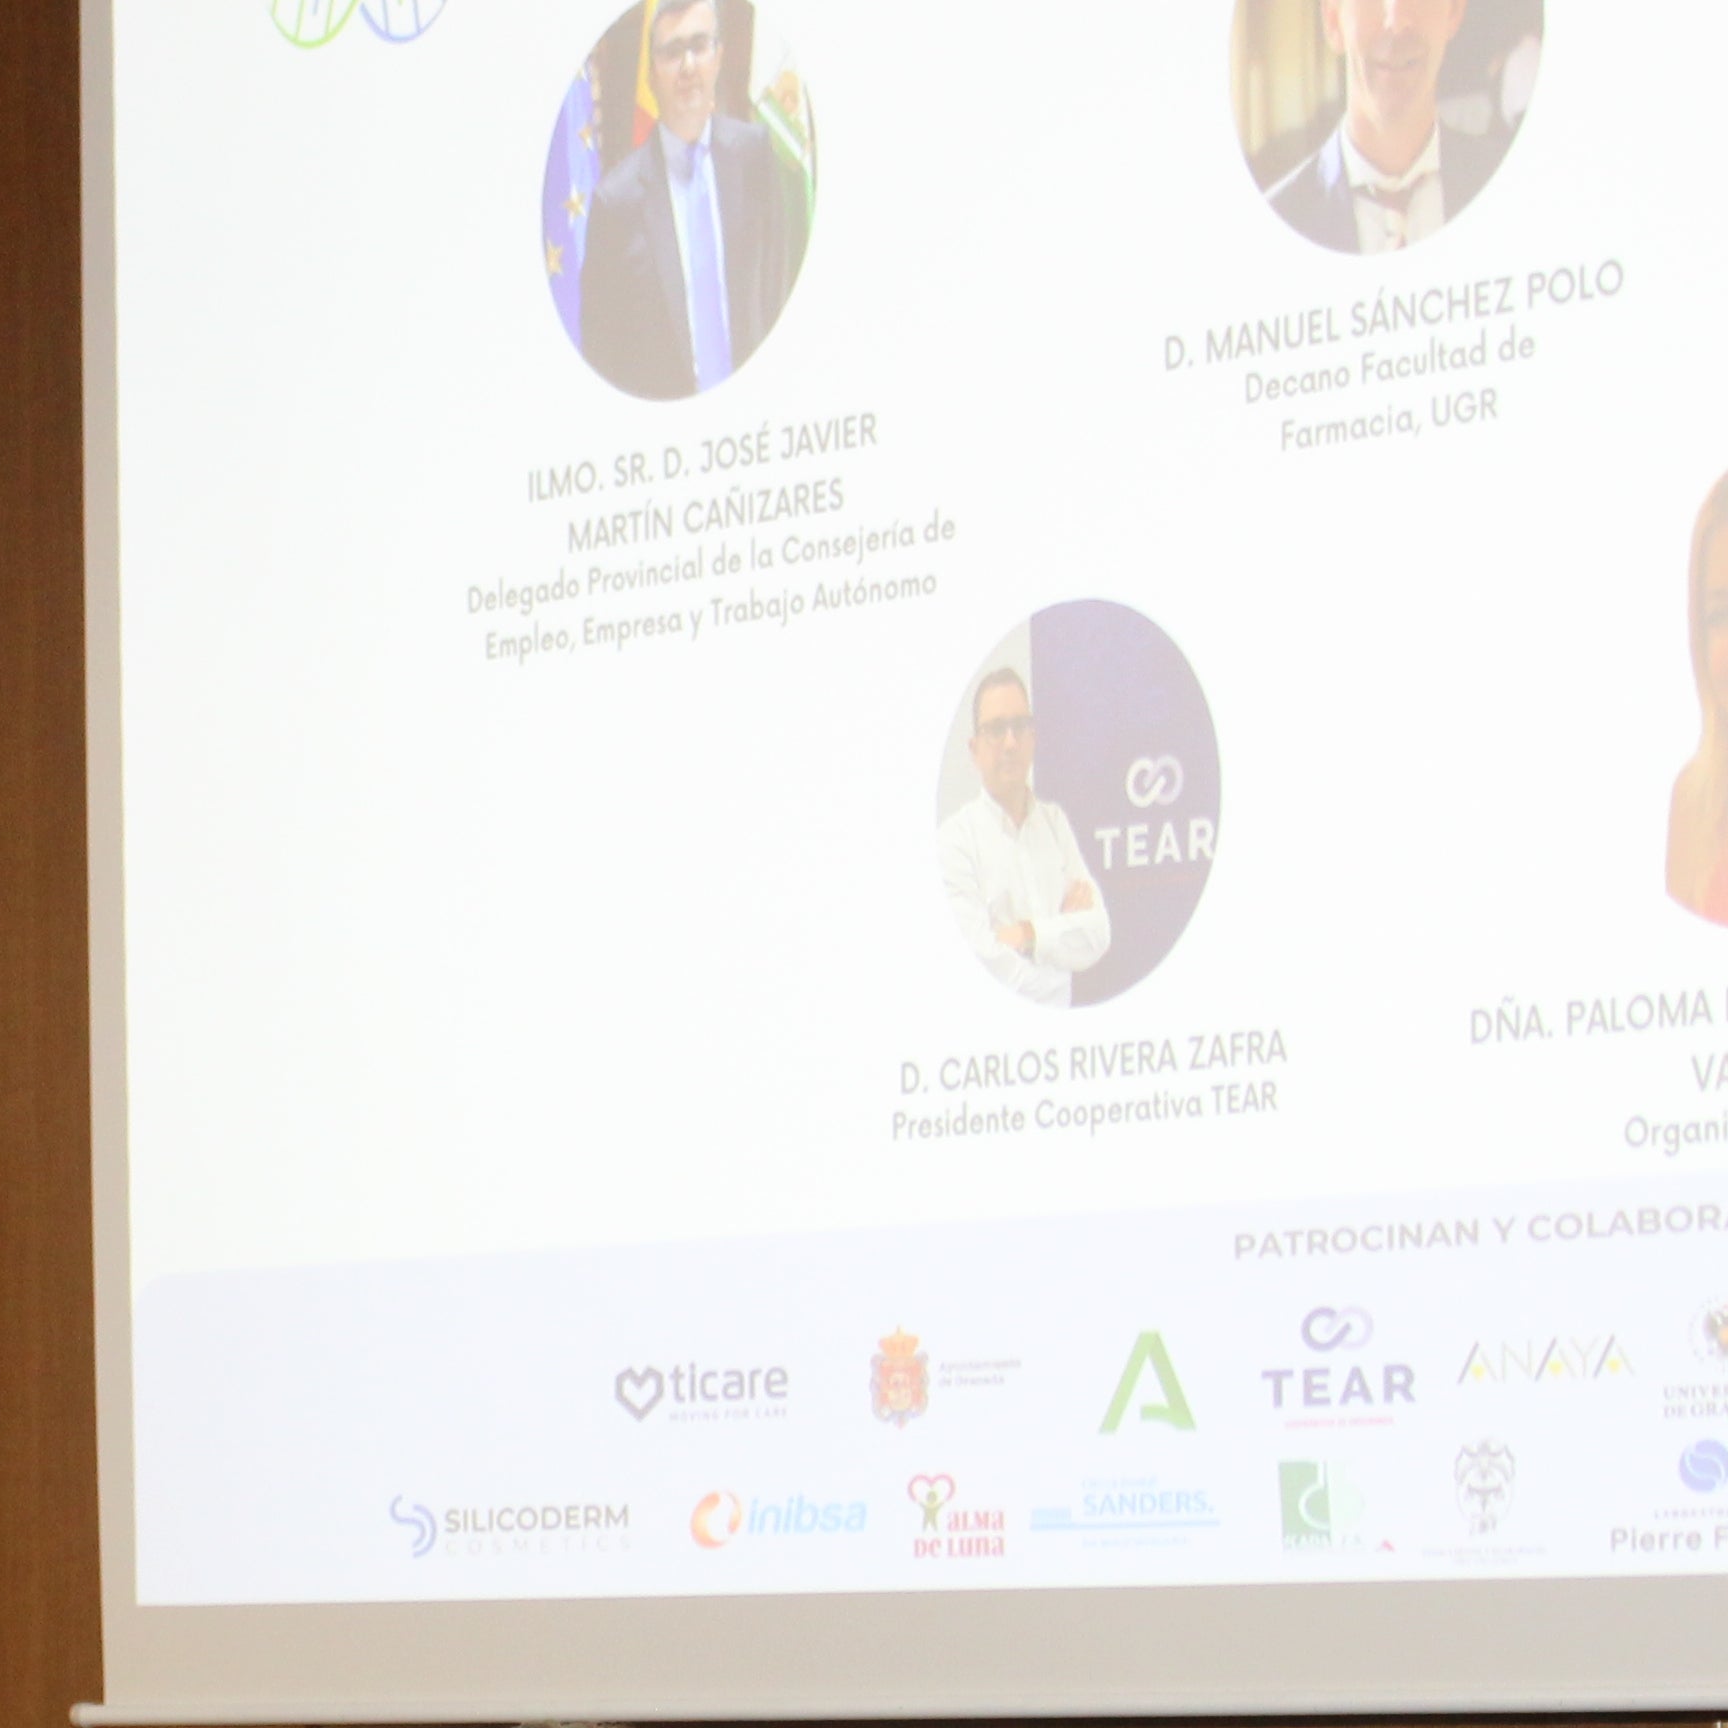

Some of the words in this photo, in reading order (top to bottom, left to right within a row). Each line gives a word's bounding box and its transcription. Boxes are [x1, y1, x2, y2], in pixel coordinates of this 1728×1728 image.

[1164, 335, 1194, 371] D.
[1206, 307, 1341, 363] MANUEL
[1350, 276, 1514, 336] SÁNCHEZ
[1526, 259, 1624, 309] POLO
[1245, 364, 1350, 404] Decano
[1361, 328, 1487, 384] Facultad
[1498, 325, 1536, 360] de
[1282, 405, 1422, 451] Farmacia,
[1431, 387, 1497, 427] UGR
[528, 462, 604, 503] ILMO.
[614, 452, 654, 487] SR.
[663, 447, 690, 480] D.
[700, 422, 769, 476] JOSÉ
[780, 412, 879, 461] JAVIER
[568, 500, 672, 554] MARTÍN
[683, 476, 844, 534] CAÑIZARES
[467, 568, 579, 615] Delegado
[588, 546, 703, 595] Provincial
[712, 542, 741, 576] de
[751, 537, 773, 569] la
[782, 518, 915, 566] Consejería
[924, 506, 956, 543] de
[486, 621, 576, 666] Empleo,
[583, 609, 682, 652] Empresa
[691, 607, 703, 642] y
[710, 588, 804, 627] Trabajo
[812, 571, 937, 612] Autónomo
[1094, 817, 1215, 870] TEAR
[1472, 996, 1553, 1045] DÑA.
[1566, 990, 1712, 1037] PALOMA
[900, 1061, 928, 1096] D.
[939, 1049, 1059, 1091] CARLOS
[1070, 1040, 1177, 1081] RIVERA
[1188, 1029, 1288, 1070] ZAFRA
[892, 1102, 1025, 1142] Presidente
[1034, 1087, 1201, 1136] Cooperativa
[1212, 1081, 1278, 1116] TEAR
[1234, 1220, 1480, 1261] PATROCINAN
[1494, 1216, 1516, 1244] Y
[670, 1362, 788, 1402] ticare
[1261, 1363, 1416, 1410] TEAR
[445, 1504, 629, 1533] SILICODERM
[747, 1495, 869, 1535] inibsa
